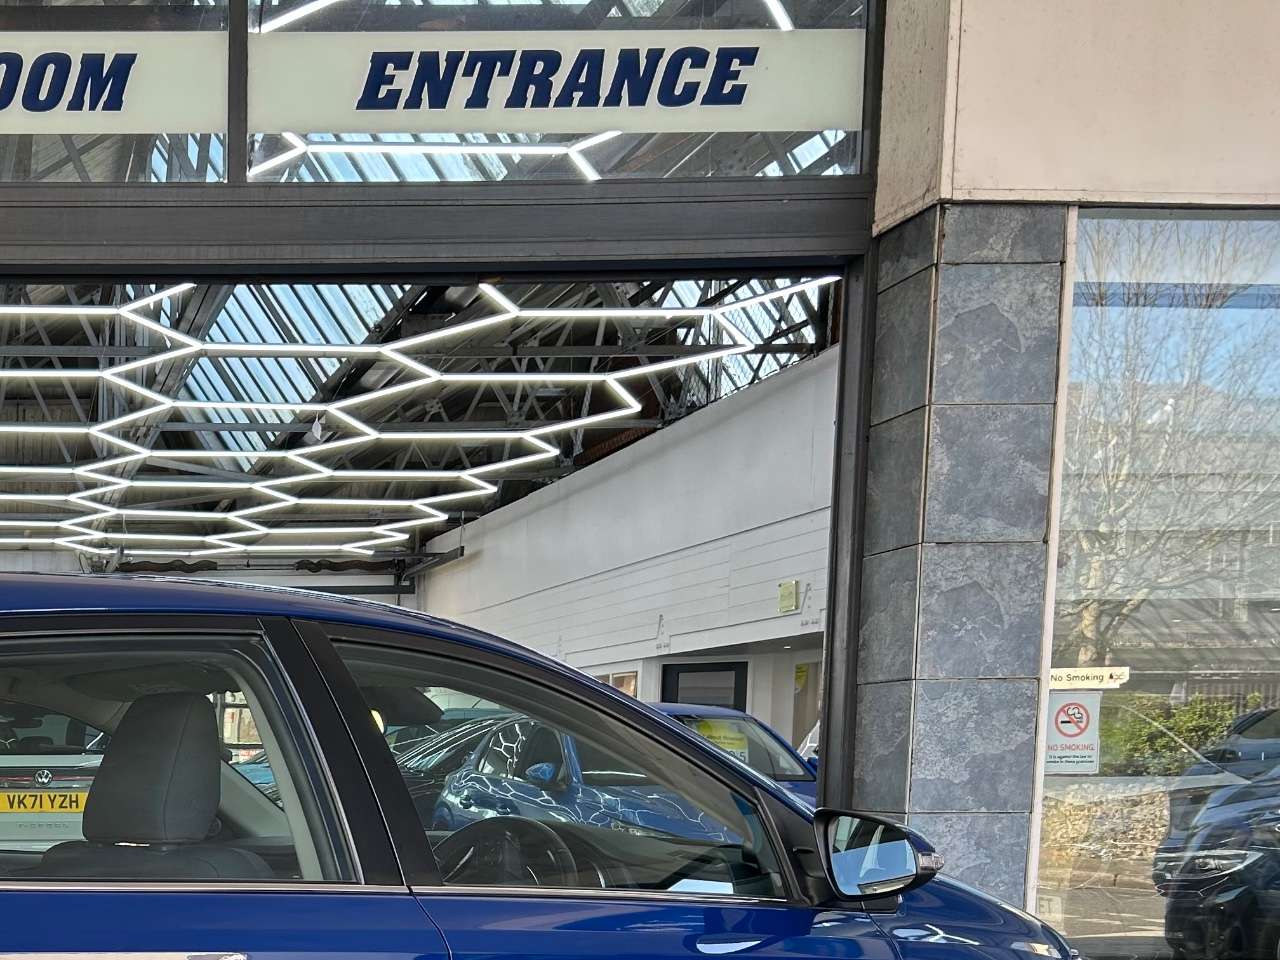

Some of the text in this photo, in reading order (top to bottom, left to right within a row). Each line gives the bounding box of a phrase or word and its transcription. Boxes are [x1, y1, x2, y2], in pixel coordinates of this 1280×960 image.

[355, 46, 760, 110] ENTRANCE
[1050, 673, 1104, 684] No Smoking
[1048, 744, 1058, 752] NO
[6, 793, 80, 810] VK71 YZH
